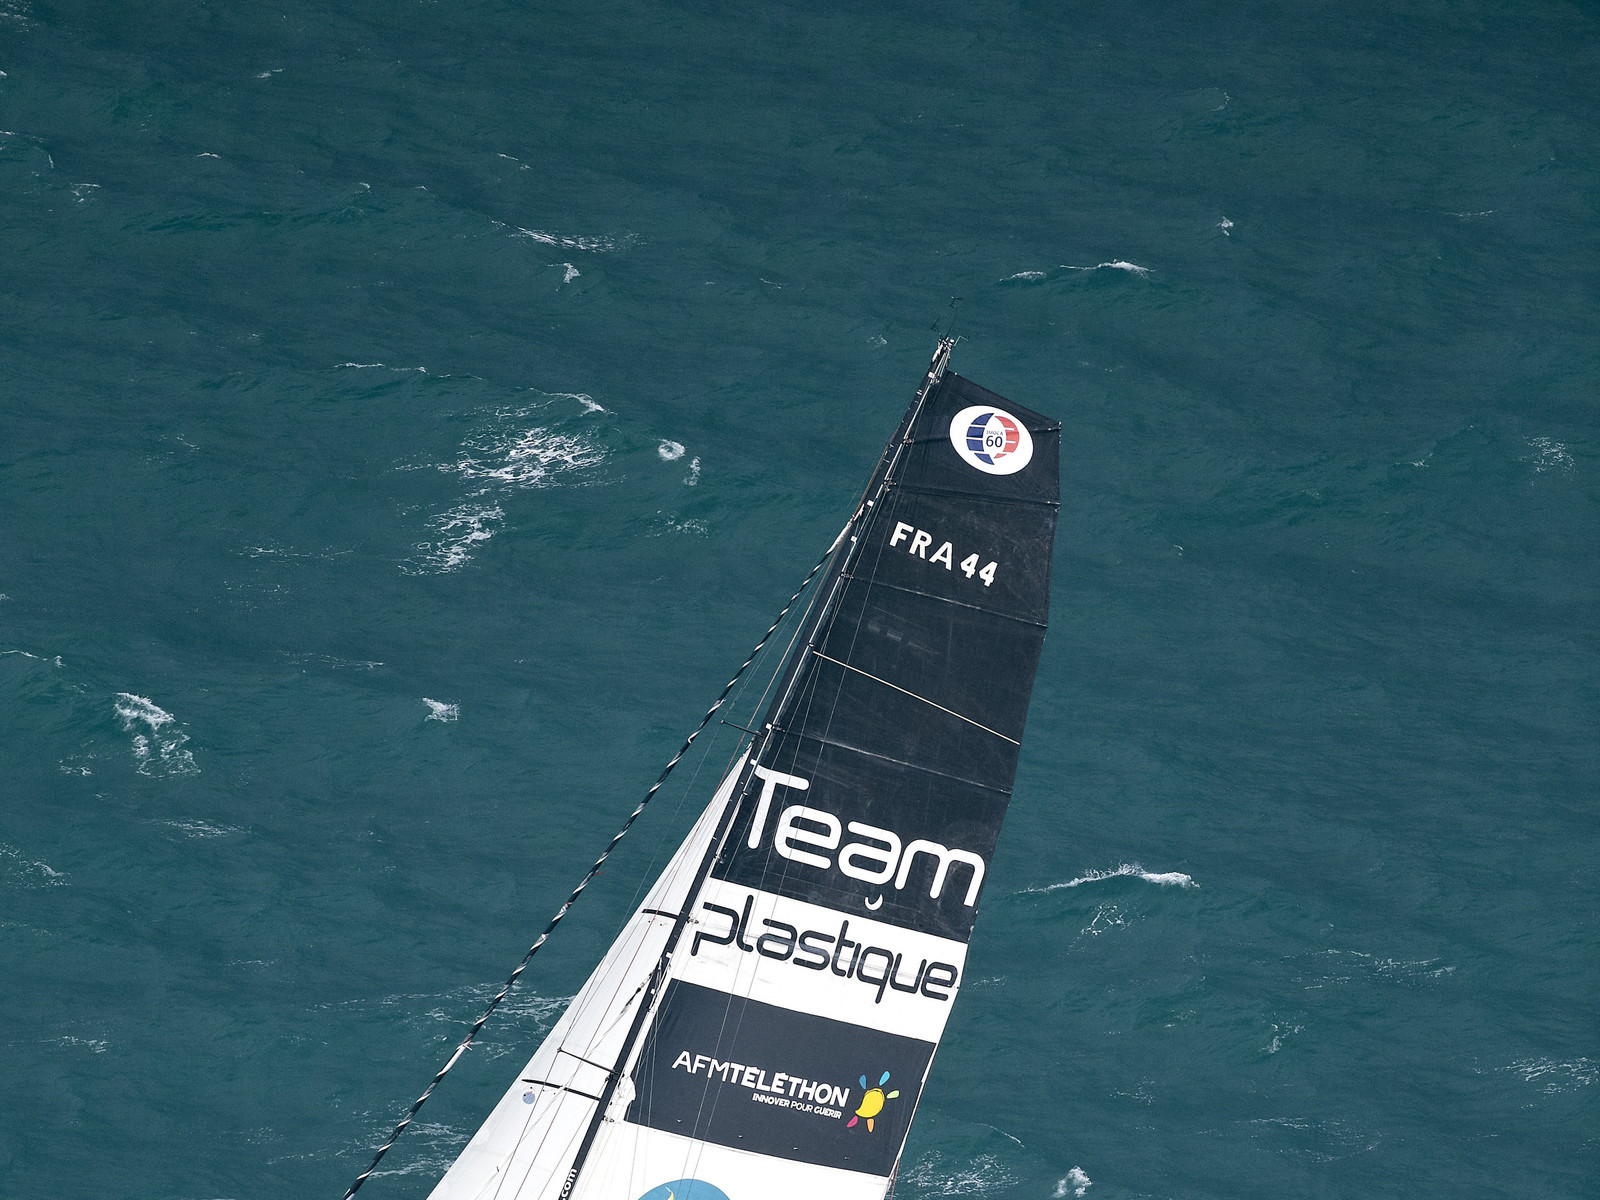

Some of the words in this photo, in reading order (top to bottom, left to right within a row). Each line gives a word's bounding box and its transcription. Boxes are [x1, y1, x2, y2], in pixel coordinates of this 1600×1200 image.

[986, 435, 1003, 448] 60
[889, 521, 953, 571] FRA
[960, 553, 998, 587] 44
[747, 759, 986, 907] Team
[690, 894, 958, 1004] plastique
[752, 1092, 791, 1108] INNOVER
[790, 1101, 814, 1113] POUR
